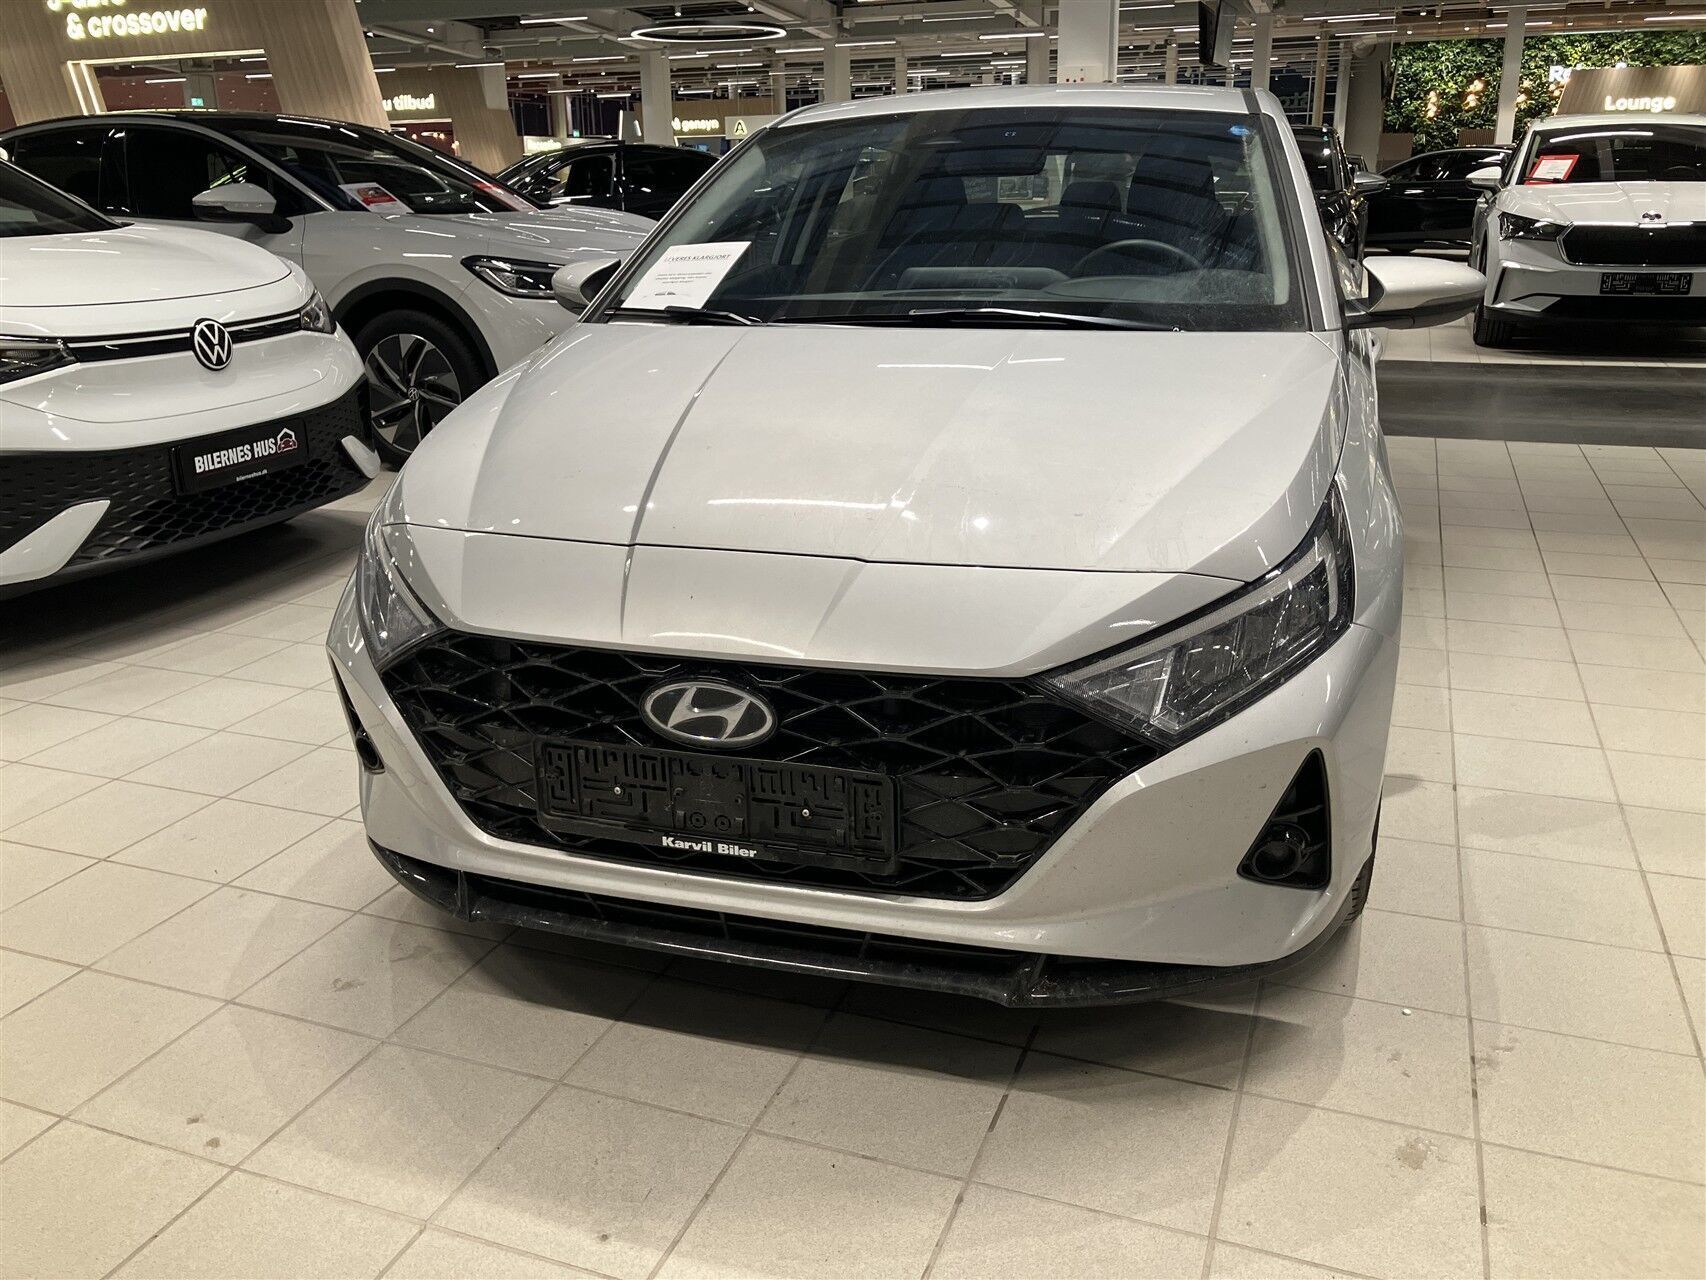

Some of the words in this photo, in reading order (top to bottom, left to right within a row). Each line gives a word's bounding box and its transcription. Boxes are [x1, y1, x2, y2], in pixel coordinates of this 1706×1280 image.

[66, 12, 86, 40] &
[87, 8, 207, 38] crossover
[393, 93, 435, 111] tilbud
[1604, 95, 1677, 113] Lounge
[194, 446, 251, 473] BILERNES
[253, 438, 276, 459] HUS
[661, 836, 712, 853] Karvil
[717, 843, 757, 858] Biler
